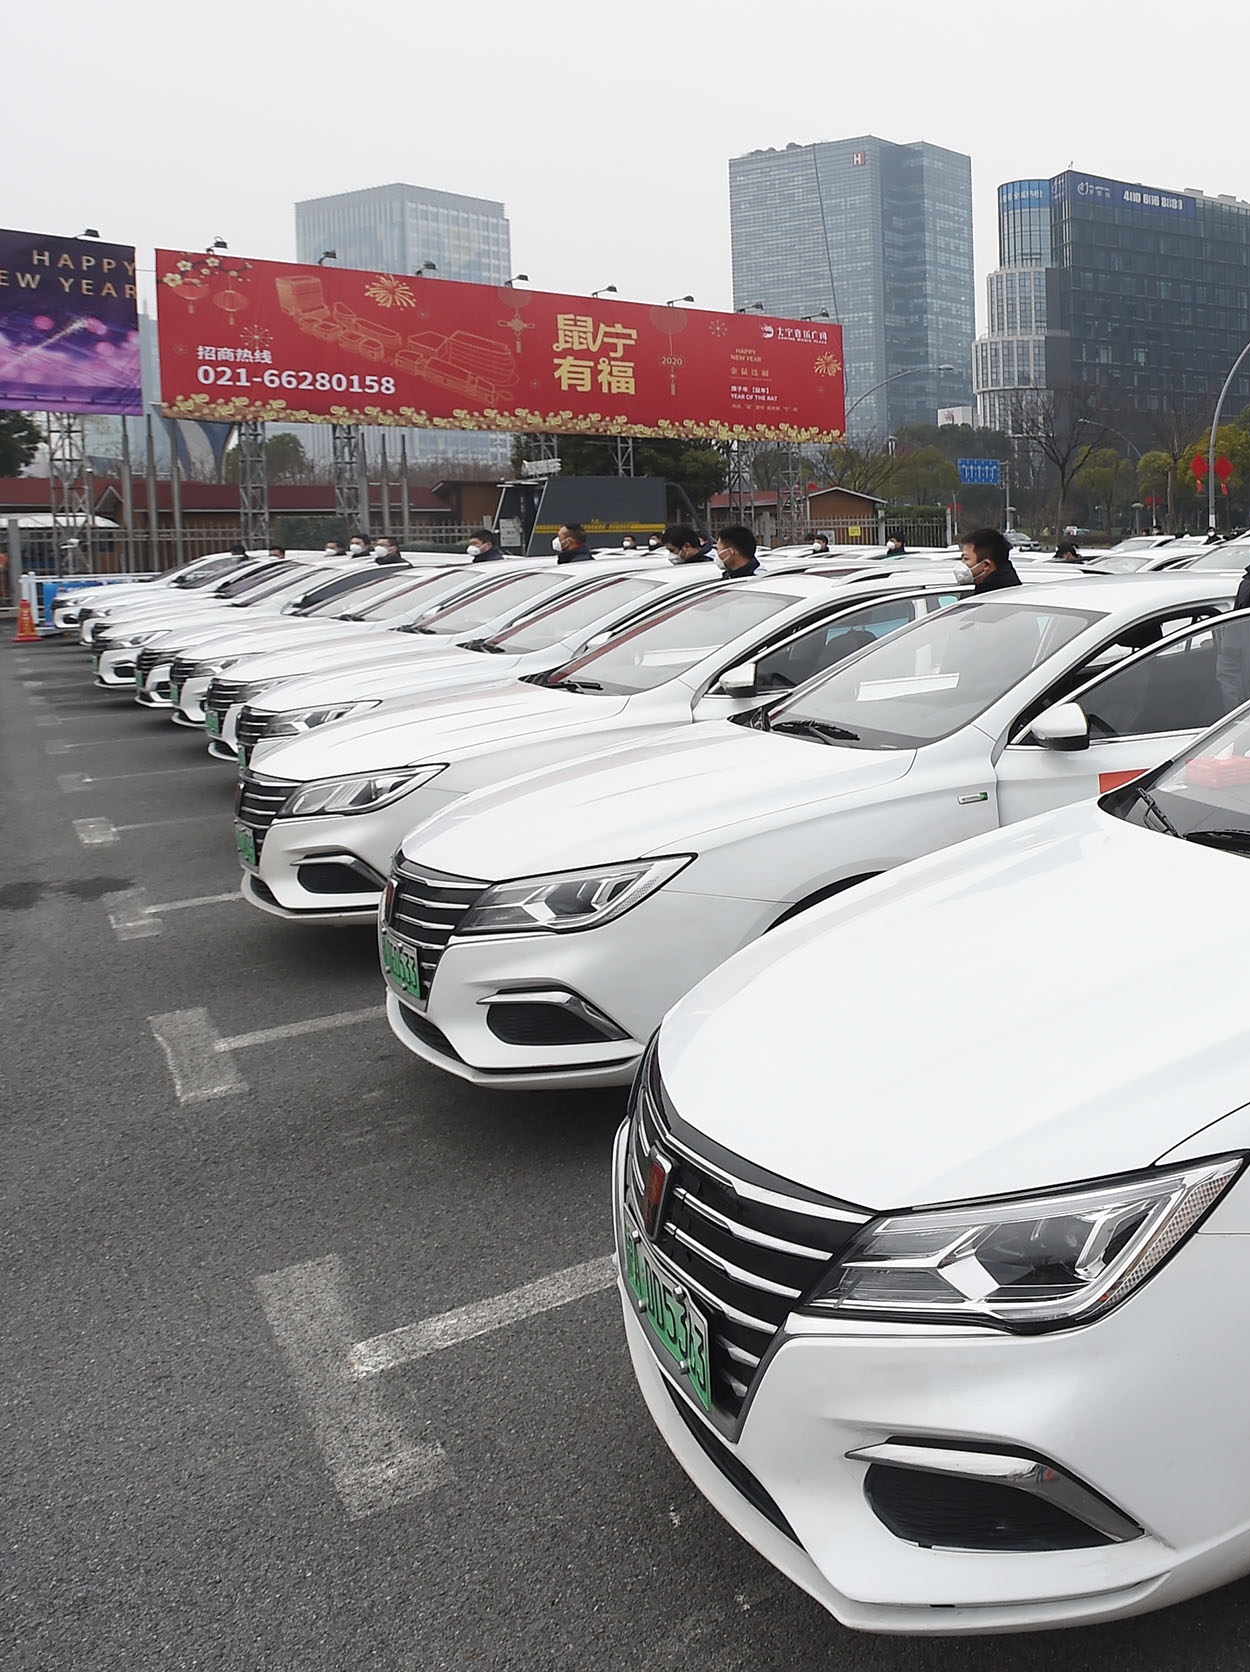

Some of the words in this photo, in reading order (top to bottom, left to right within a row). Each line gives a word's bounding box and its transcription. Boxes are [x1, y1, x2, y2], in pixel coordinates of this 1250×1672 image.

[32, 249, 135, 276] HAPPY
[58, 276, 137, 300] YEAR
[196, 345, 273, 364] 招商热线
[661, 356, 683, 366] 2020
[730, 353, 745, 361] NEW
[746, 355, 762, 363] YEAR
[735, 348, 756, 356] HAPPY
[197, 365, 396, 395] 021-66280158
[553, 355, 636, 395] 有福
